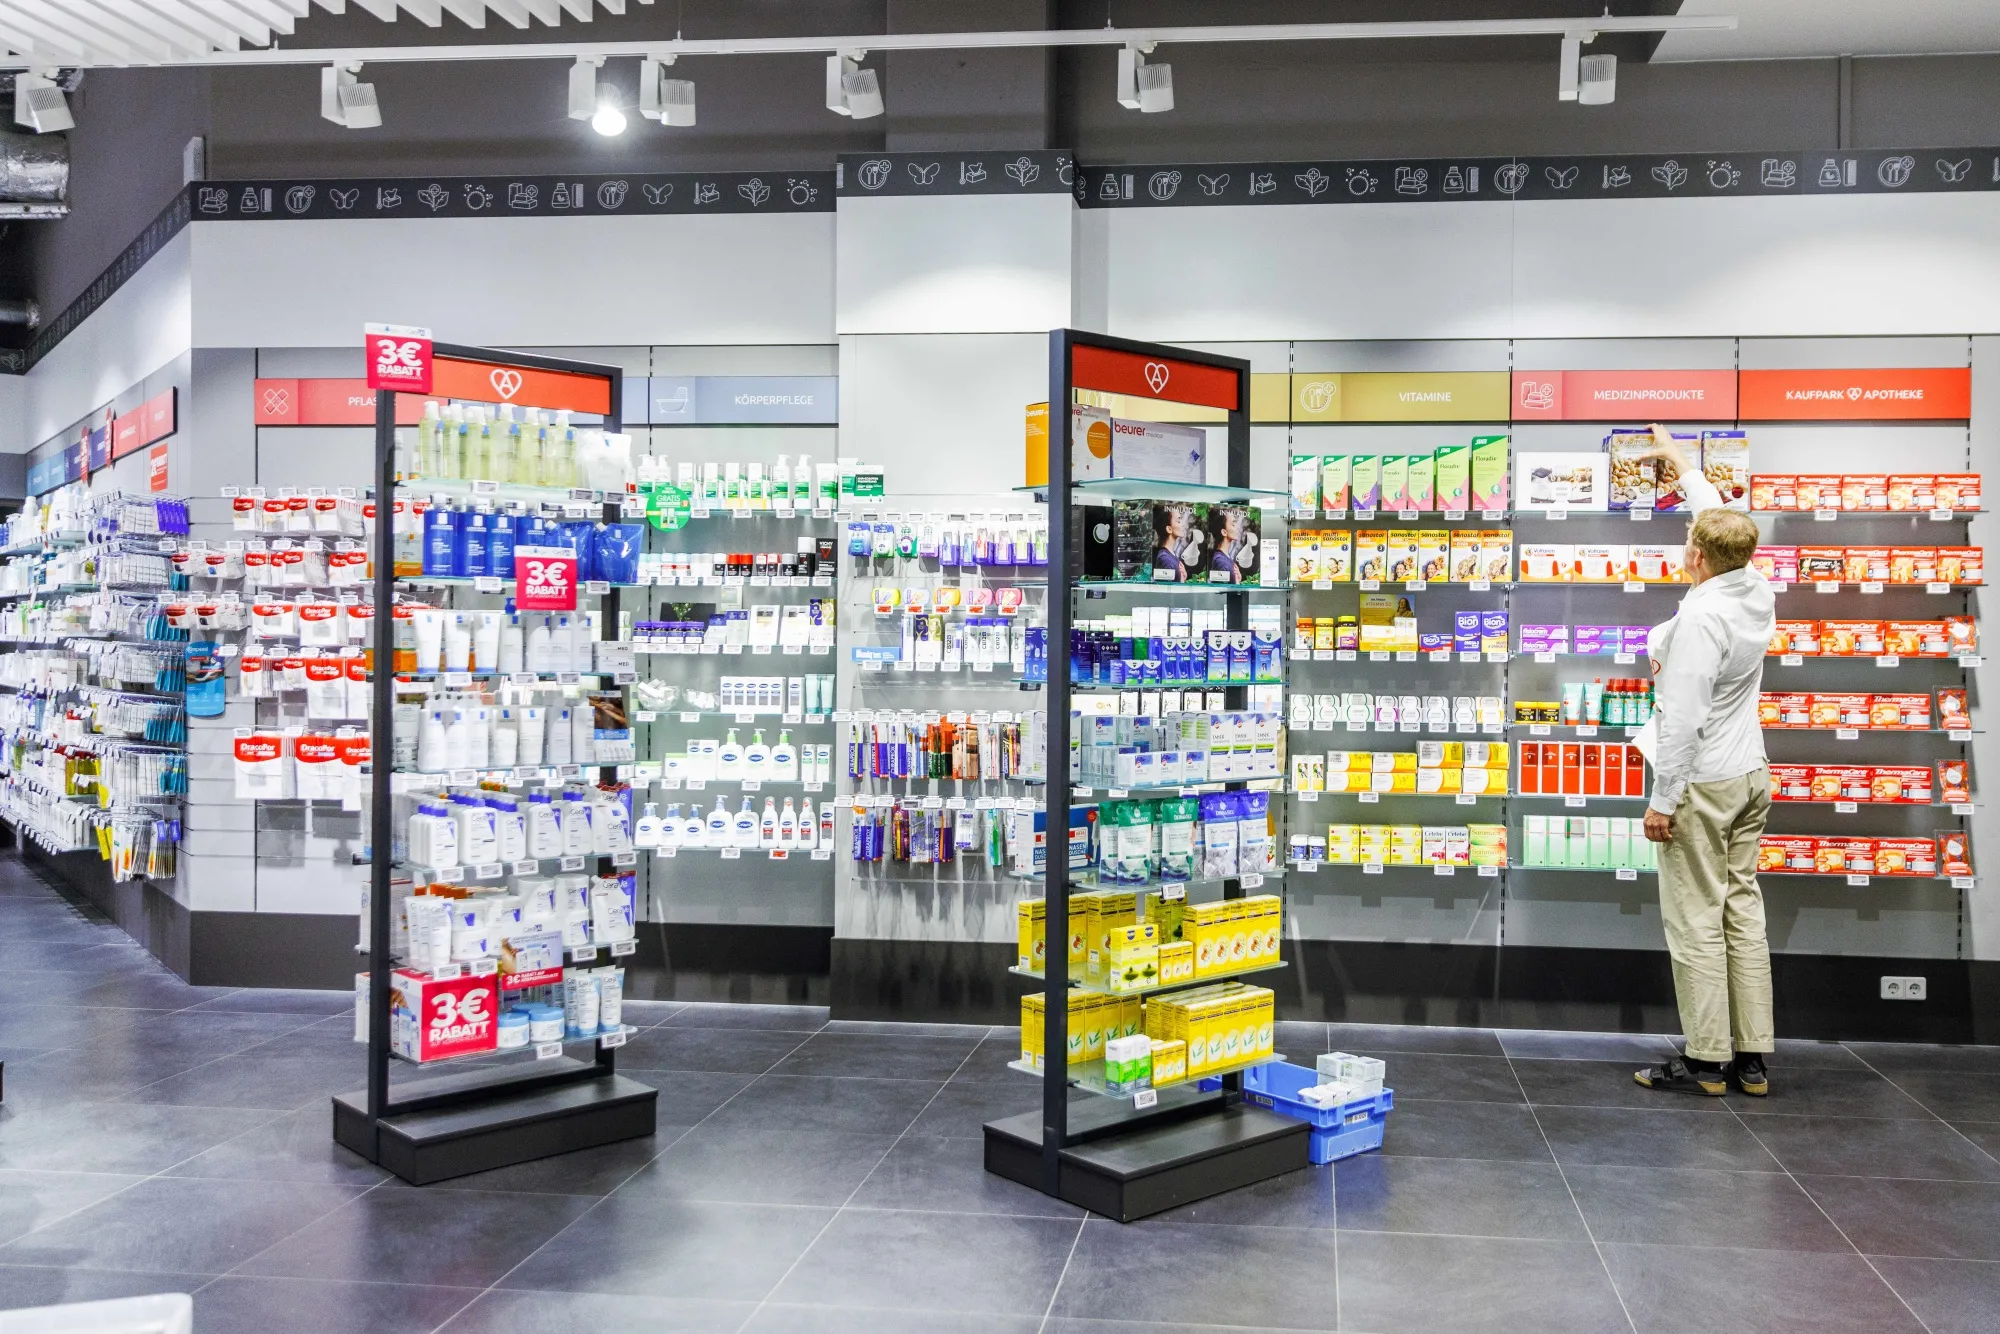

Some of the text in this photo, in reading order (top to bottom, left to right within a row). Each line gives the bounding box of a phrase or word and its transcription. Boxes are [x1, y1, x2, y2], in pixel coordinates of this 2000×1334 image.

[376, 339, 423, 367] 3€
[377, 364, 424, 377] RABATT
[735, 393, 814, 406] KÖRPERPFLEGE
[1399, 392, 1452, 402] VITAMINE
[1594, 390, 1704, 400] MEDIZINPRODUKTE
[1786, 389, 1924, 400] KAUFPARK APOTHEKE
[1114, 420, 1146, 436] beurer
[525, 560, 568, 586] 3€
[526, 585, 569, 595] RABATT
[1826, 622, 1878, 631] ThermaCare
[1890, 622, 1944, 632] ThermaCare
[240, 742, 275, 750] DracoPor
[300, 743, 336, 752] DracoPor
[1818, 840, 1874, 848] ThermaCare
[1878, 841, 1932, 849] ThermaCare
[506, 974, 520, 985] 3€
[430, 988, 490, 1028] 3€
[429, 1020, 492, 1042] RABATT
